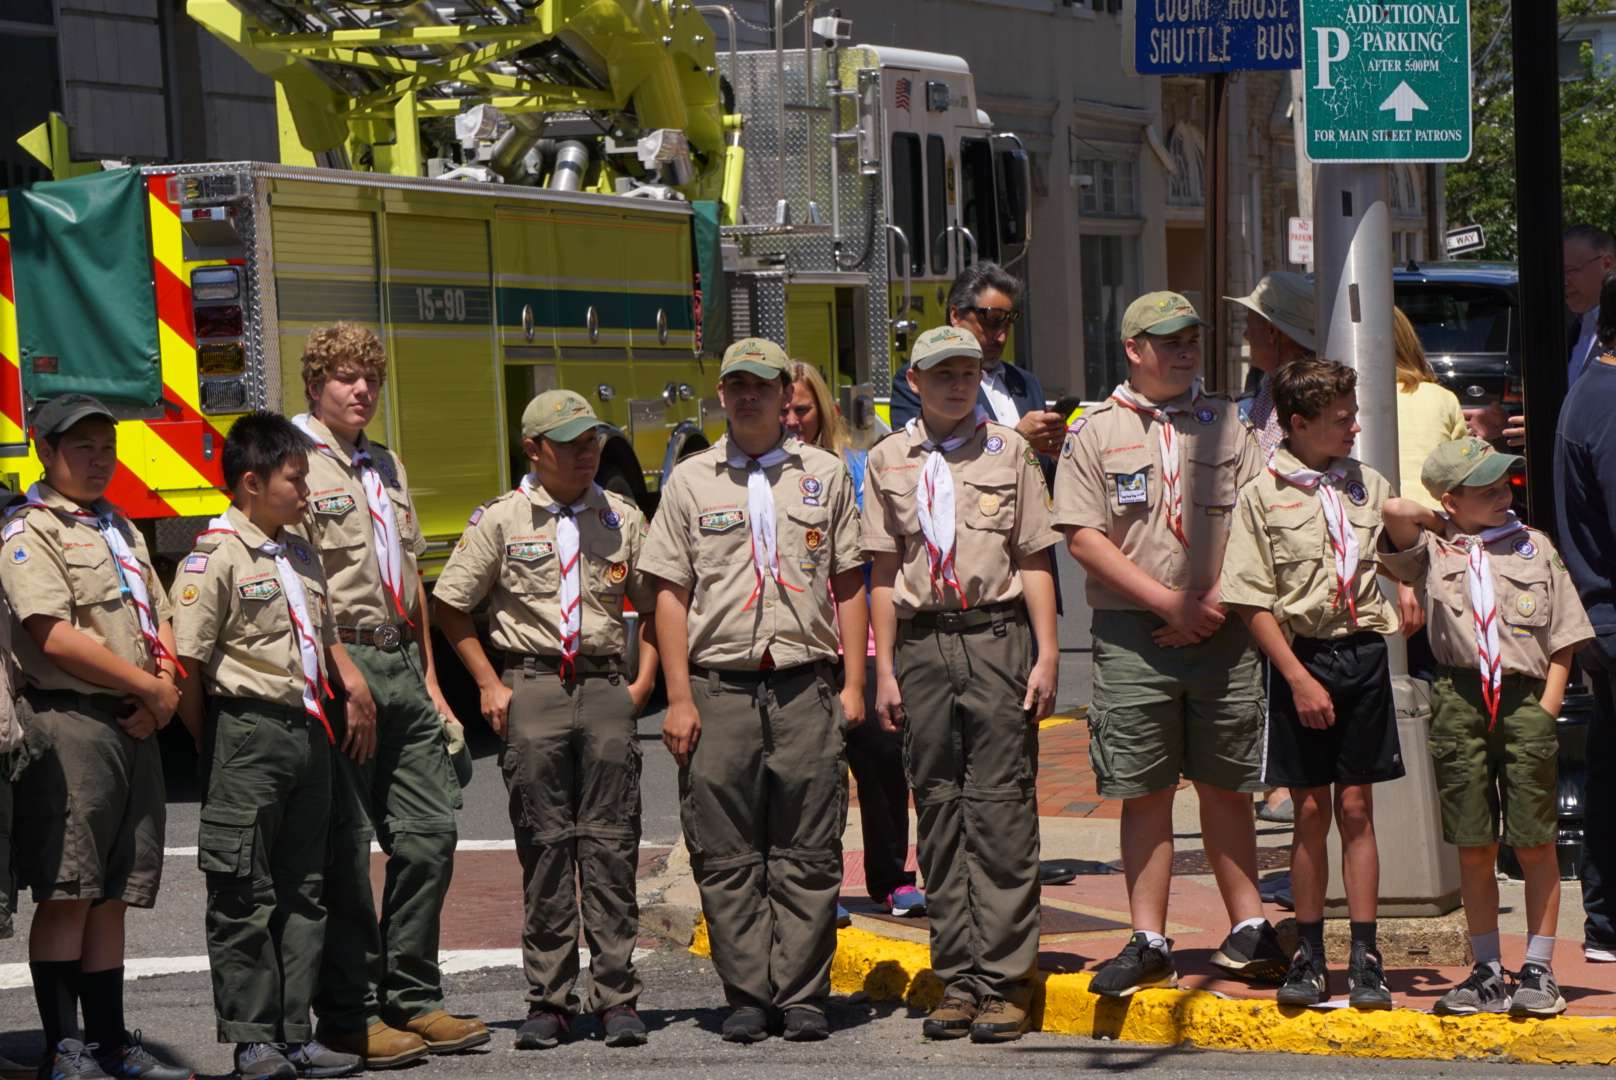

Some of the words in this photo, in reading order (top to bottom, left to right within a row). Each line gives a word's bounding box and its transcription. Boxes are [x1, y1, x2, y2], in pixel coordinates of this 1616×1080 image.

[1228, 0, 1289, 20] HOUSE
[1345, 4, 1460, 25] ADDITIONAL
[1149, 25, 1232, 64] SHUTTLE
[1257, 24, 1295, 61] BUS
[1362, 31, 1444, 52] PARKING
[1311, 27, 1351, 90] P
[1367, 59, 1402, 72] AFTER
[1405, 59, 1440, 72] 5:00PM
[1314, 129, 1336, 142] FOR
[1339, 129, 1369, 142] MAIN
[1415, 129, 1463, 142] PATRONS
[1456, 232, 1476, 246] WAY
[416, 288, 466, 321] 15-90
